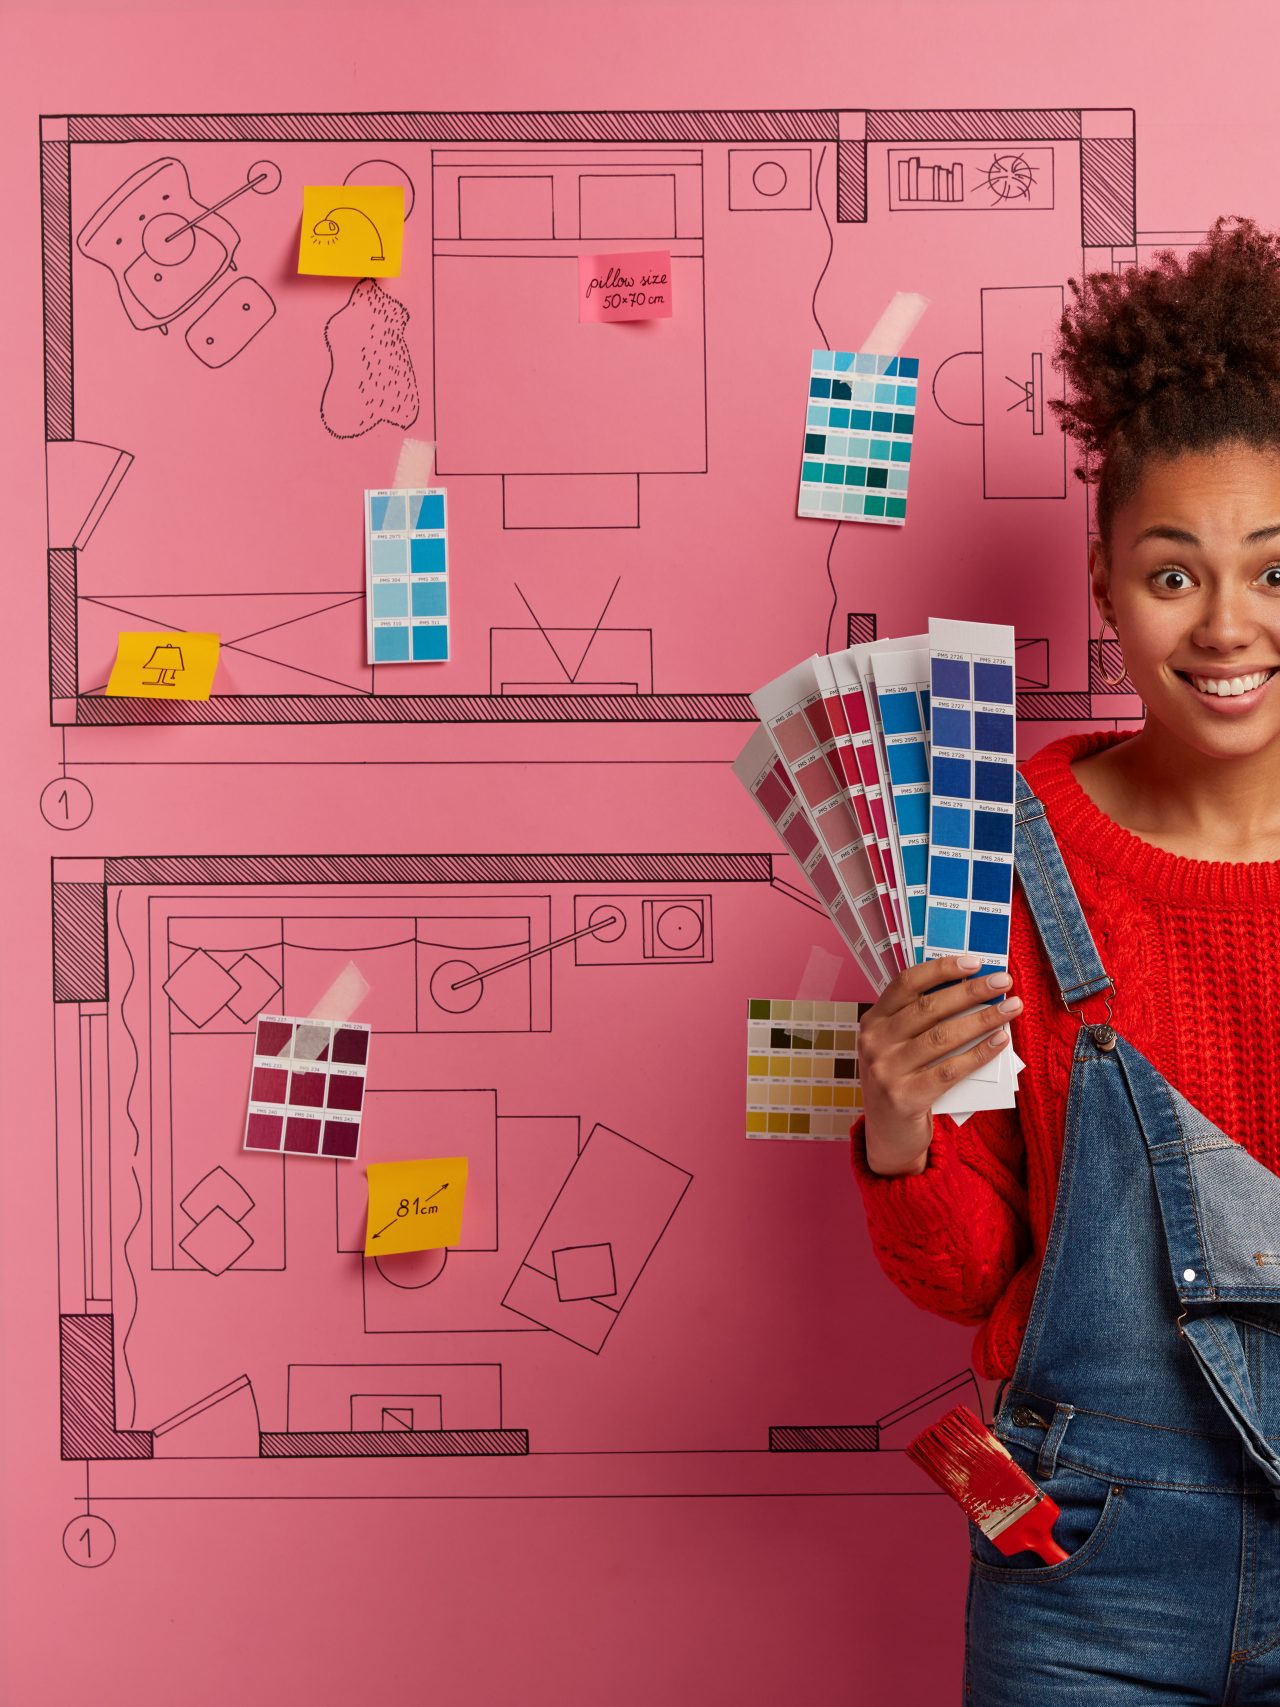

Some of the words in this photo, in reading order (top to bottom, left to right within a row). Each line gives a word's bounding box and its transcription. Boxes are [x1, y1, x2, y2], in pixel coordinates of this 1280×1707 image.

[586, 267, 635, 298] pillow
[640, 269, 667, 287] size
[648, 295, 664, 304] cm
[58, 790, 69, 820] 1
[80, 1528, 91, 1558] 1
